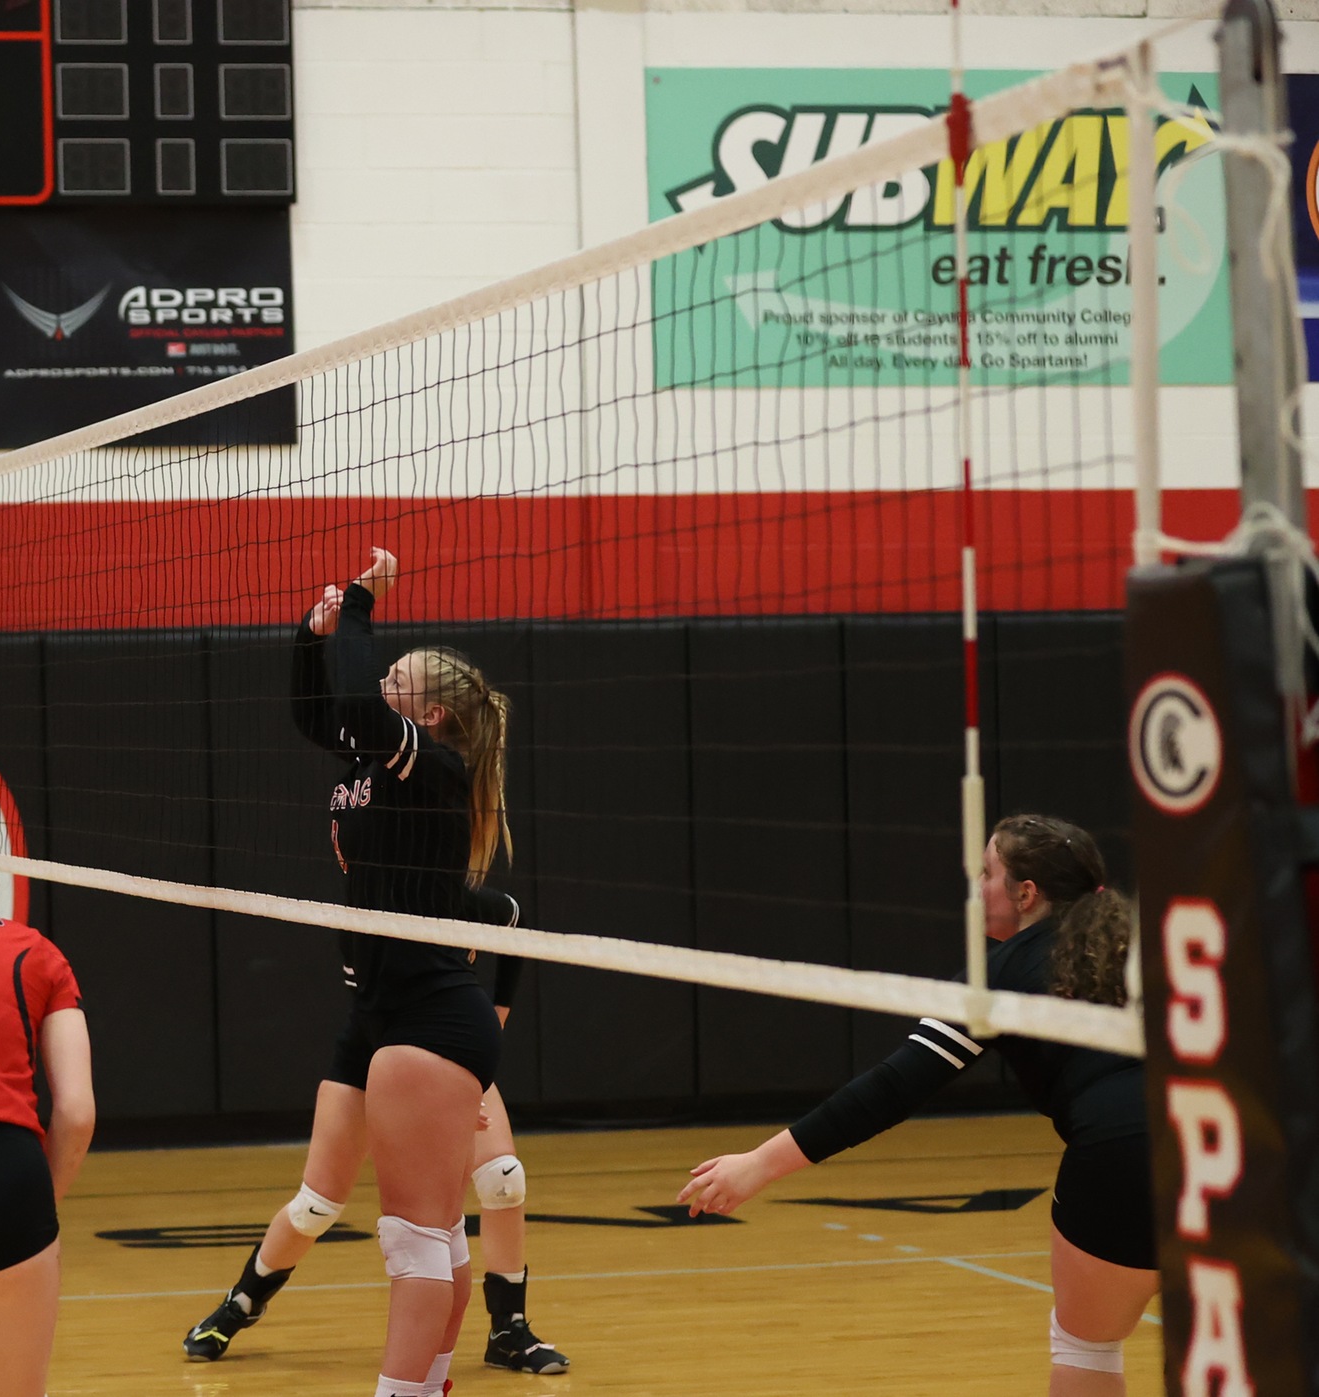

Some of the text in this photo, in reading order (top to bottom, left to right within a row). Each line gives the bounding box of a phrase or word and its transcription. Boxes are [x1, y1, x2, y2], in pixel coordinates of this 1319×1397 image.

[931, 244, 1166, 286] eat fres.
[118, 286, 284, 313] ADPRO
[127, 307, 284, 325] SPORTS
[763, 308, 1131, 327] Proud sponsor of Cayua Community Colleg
[886, 331, 959, 347] students
[977, 331, 1011, 347] 15%
[1017, 331, 1037, 346] off
[1043, 332, 1060, 346] to
[1065, 330, 1119, 346] alumni
[828, 353, 849, 369] All
[892, 353, 939, 371] Every
[981, 352, 1005, 369] Go
[1009, 352, 1088, 371] Spartans!
